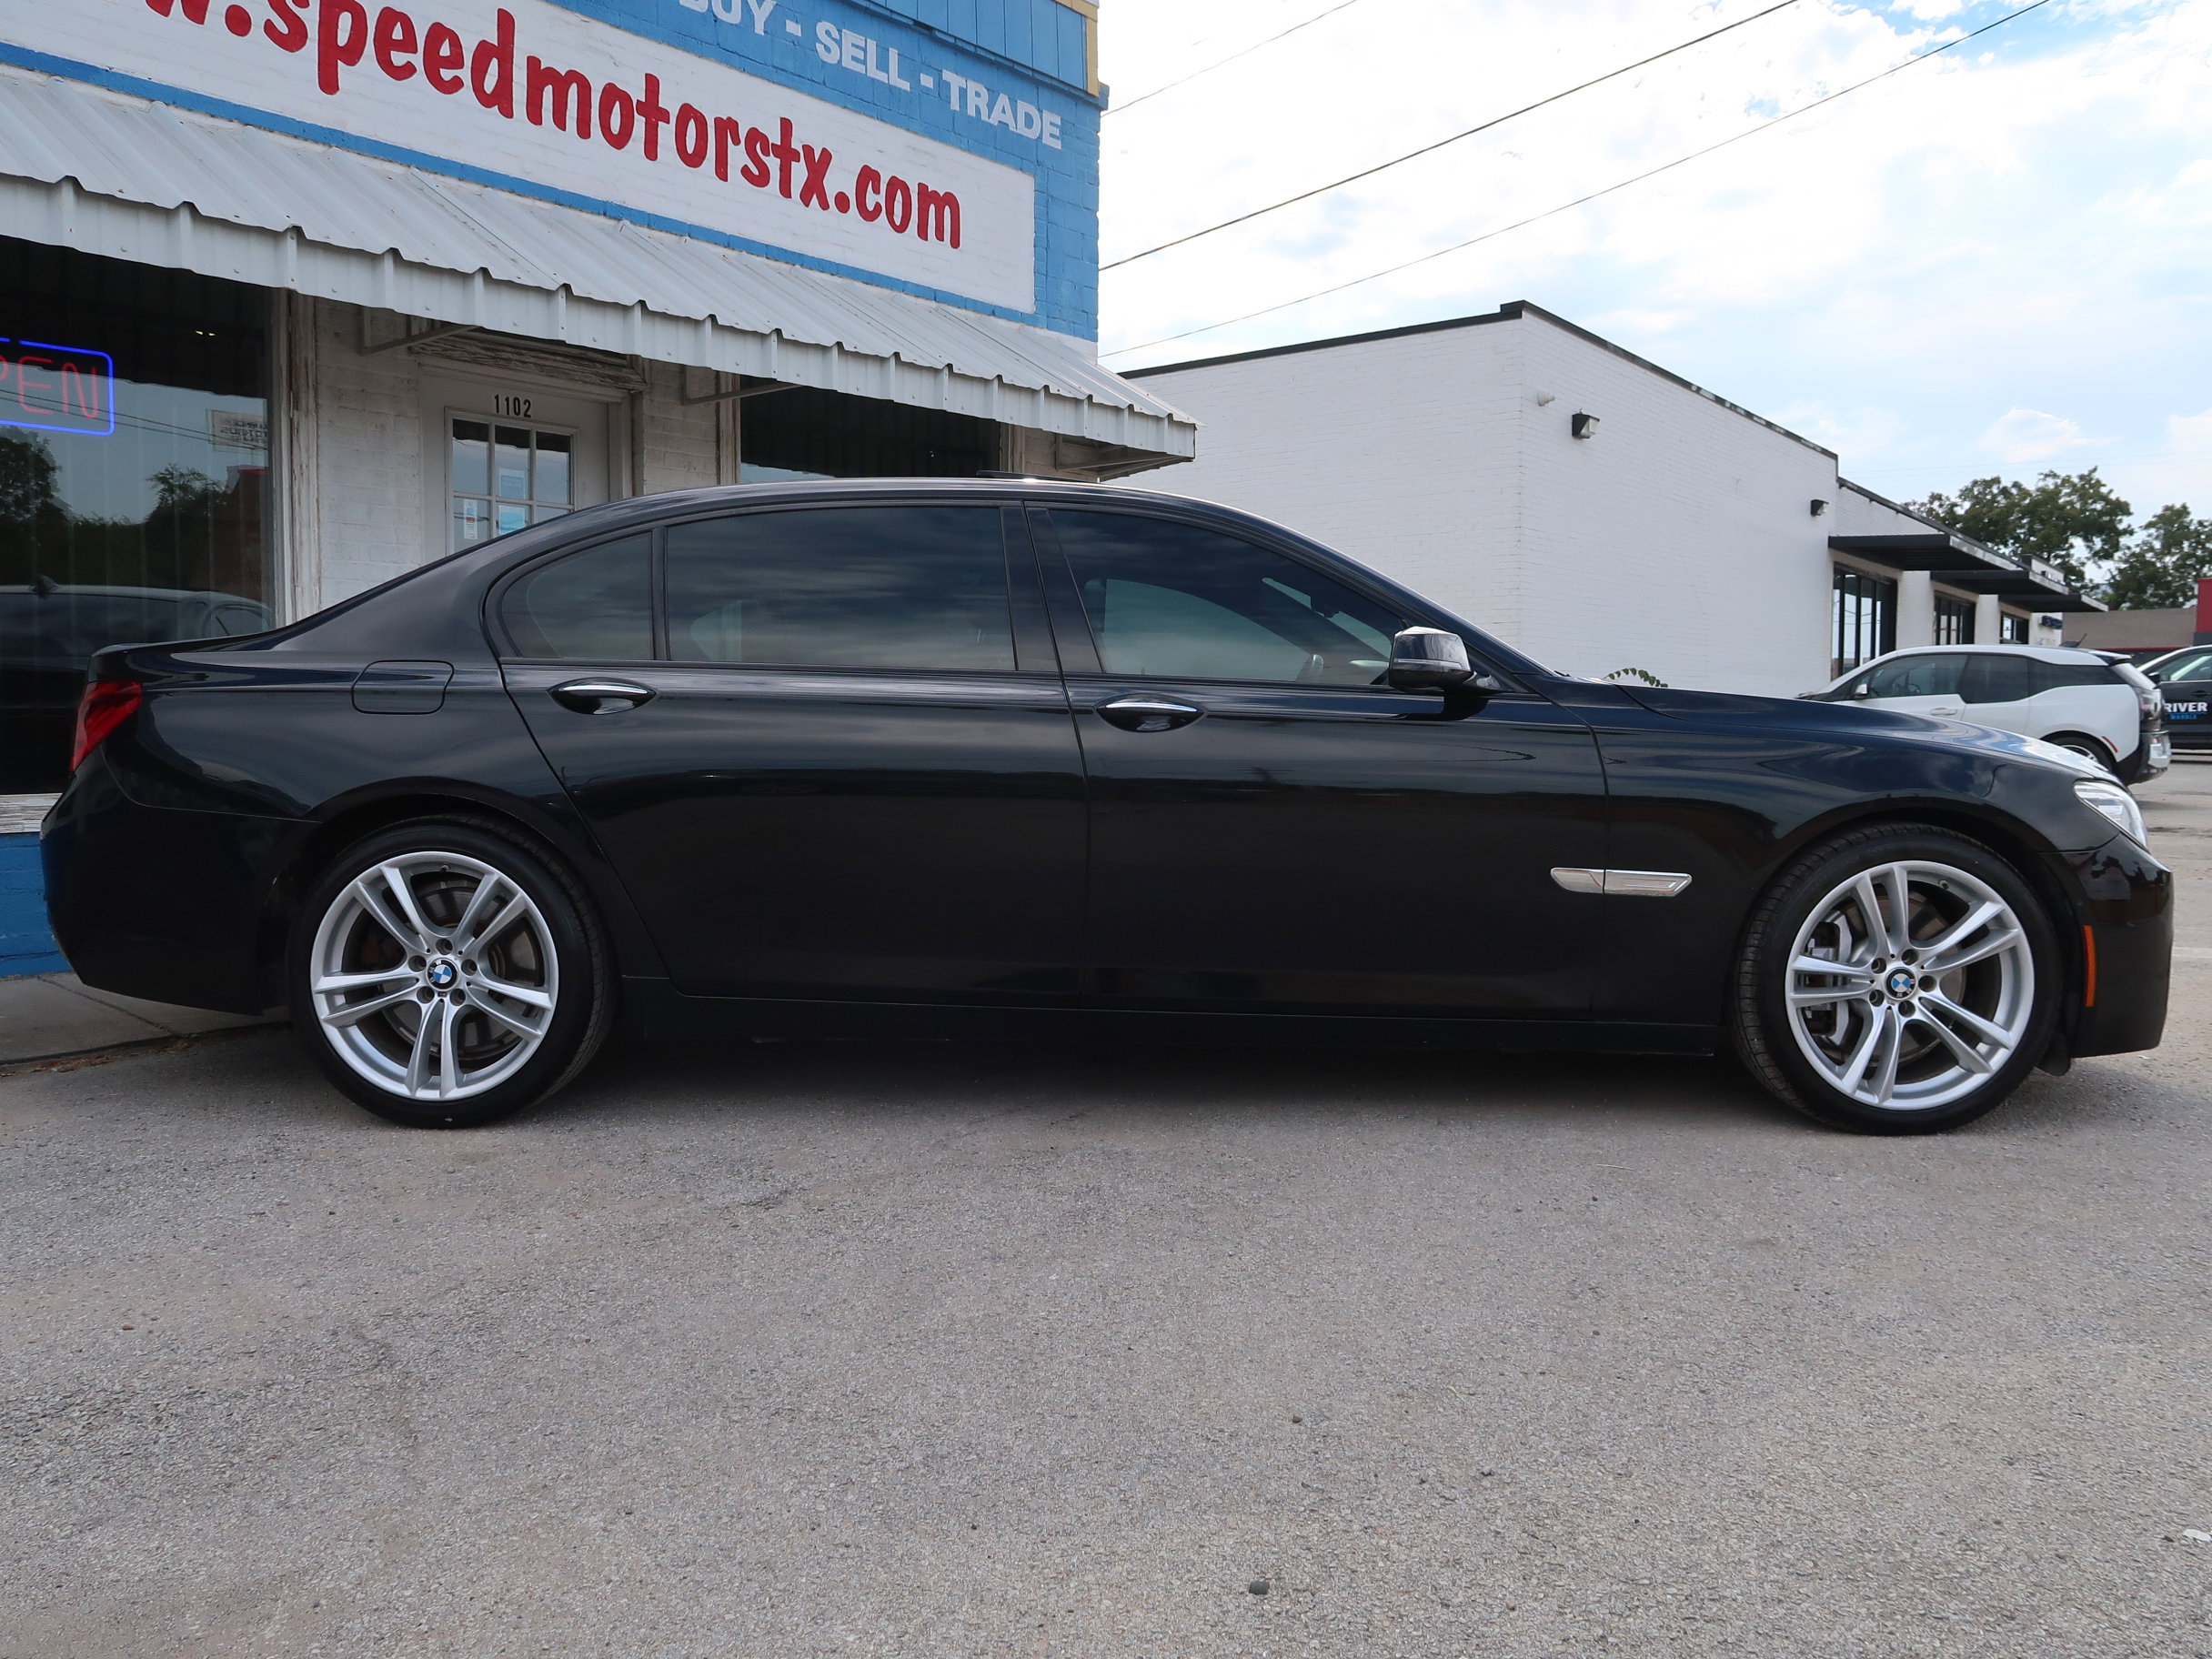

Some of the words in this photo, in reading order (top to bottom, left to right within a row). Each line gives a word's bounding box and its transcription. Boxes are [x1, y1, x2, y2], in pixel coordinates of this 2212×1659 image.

[816, 22, 910, 92] SELL
[941, 70, 1062, 150] TRADE
[0, 356, 98, 418] EN
[494, 394, 532, 418] 1102
